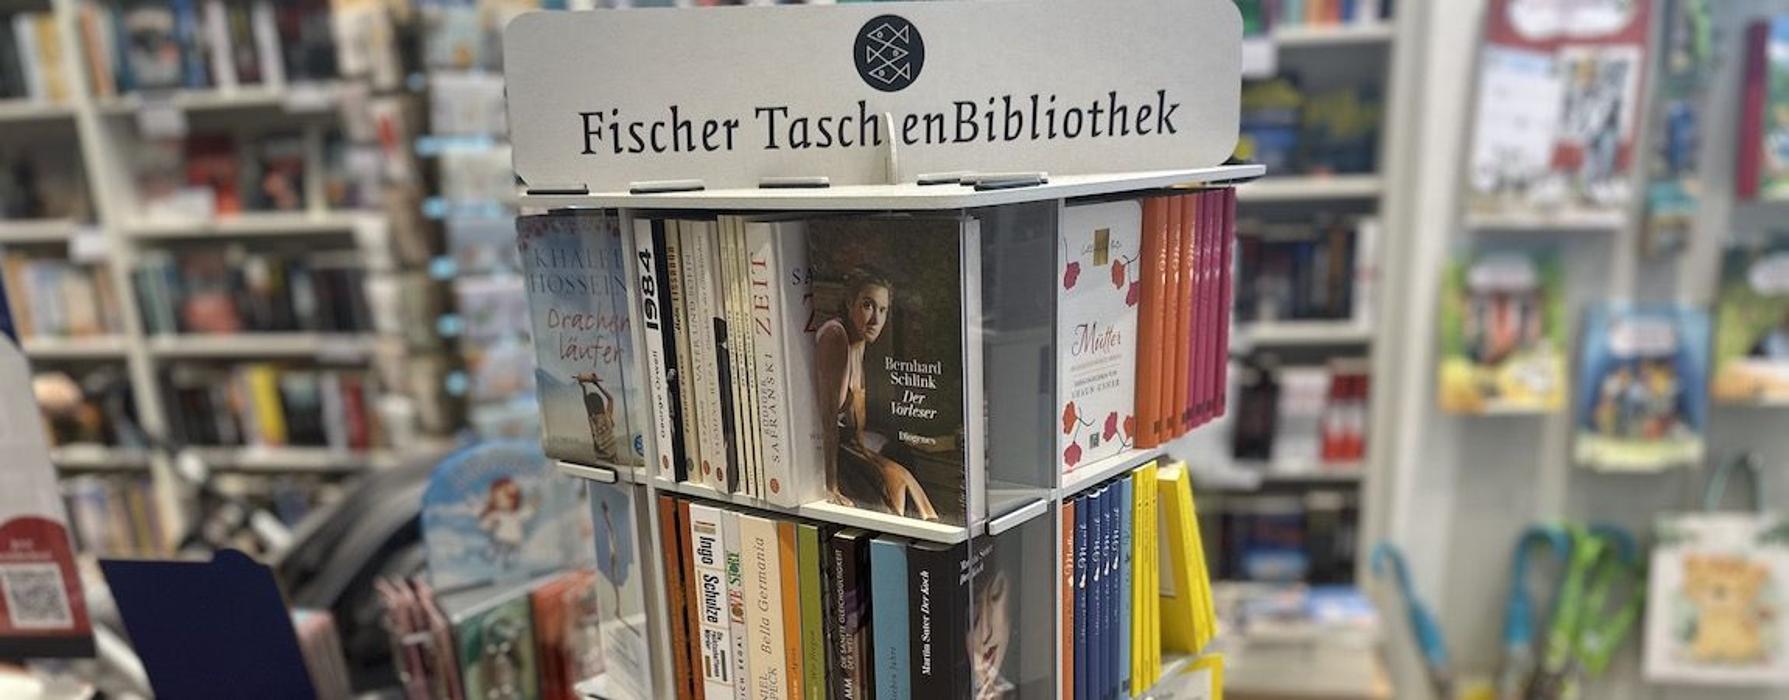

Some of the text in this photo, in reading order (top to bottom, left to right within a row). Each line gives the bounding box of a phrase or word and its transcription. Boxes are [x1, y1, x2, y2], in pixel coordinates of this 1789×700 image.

[579, 108, 739, 155] Fischer
[638, 248, 659, 331] 1984
[750, 251, 772, 338] ZEIT
[548, 302, 632, 334] Drachen
[559, 331, 625, 367] läufer
[884, 355, 943, 376] Bernhard
[651, 350, 666, 439] George Orwell
[889, 371, 937, 390] Schlink
[901, 389, 926, 405] Der
[766, 353, 781, 464] SAFRANSKI
[889, 402, 938, 421] Vorleser
[898, 430, 937, 446] Diogenes
[697, 536, 716, 565] Ingo
[703, 574, 720, 623] Schulze
[728, 553, 745, 625] LOVE STORY
[754, 537, 772, 655] Bella Germania
[919, 570, 932, 676] Martin Suter Der Koch
[840, 654, 848, 669] DIE
